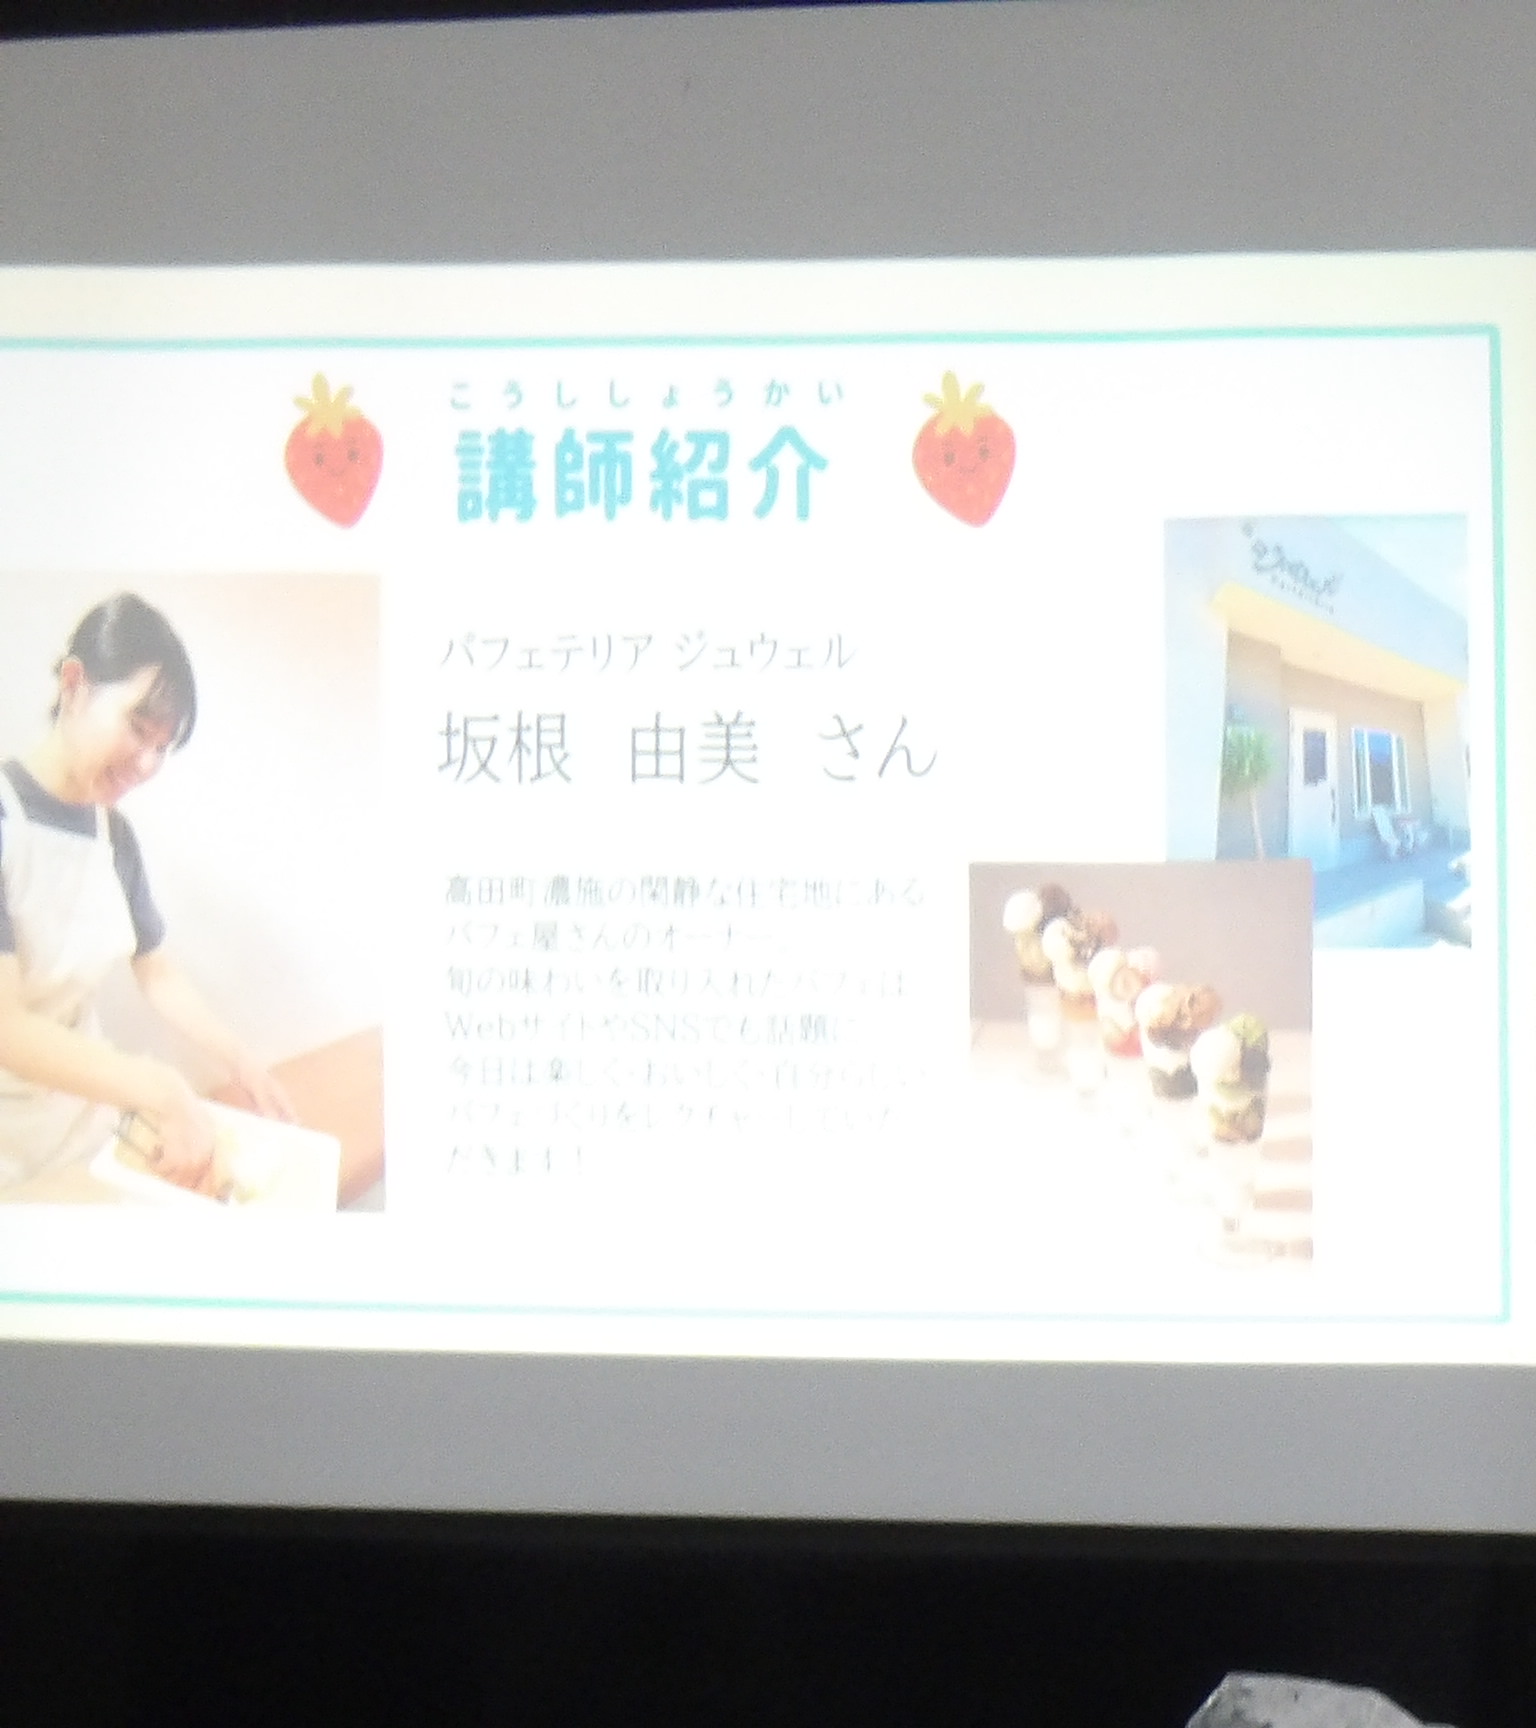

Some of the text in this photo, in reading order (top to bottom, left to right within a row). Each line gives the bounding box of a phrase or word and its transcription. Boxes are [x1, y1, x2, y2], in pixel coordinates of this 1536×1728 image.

[449, 378, 846, 411] こうししょうかい
[454, 426, 831, 523] 講師紹介
[439, 630, 855, 672] パフェテリア ジュウェル
[437, 709, 938, 784] 坂根 由美 さん
